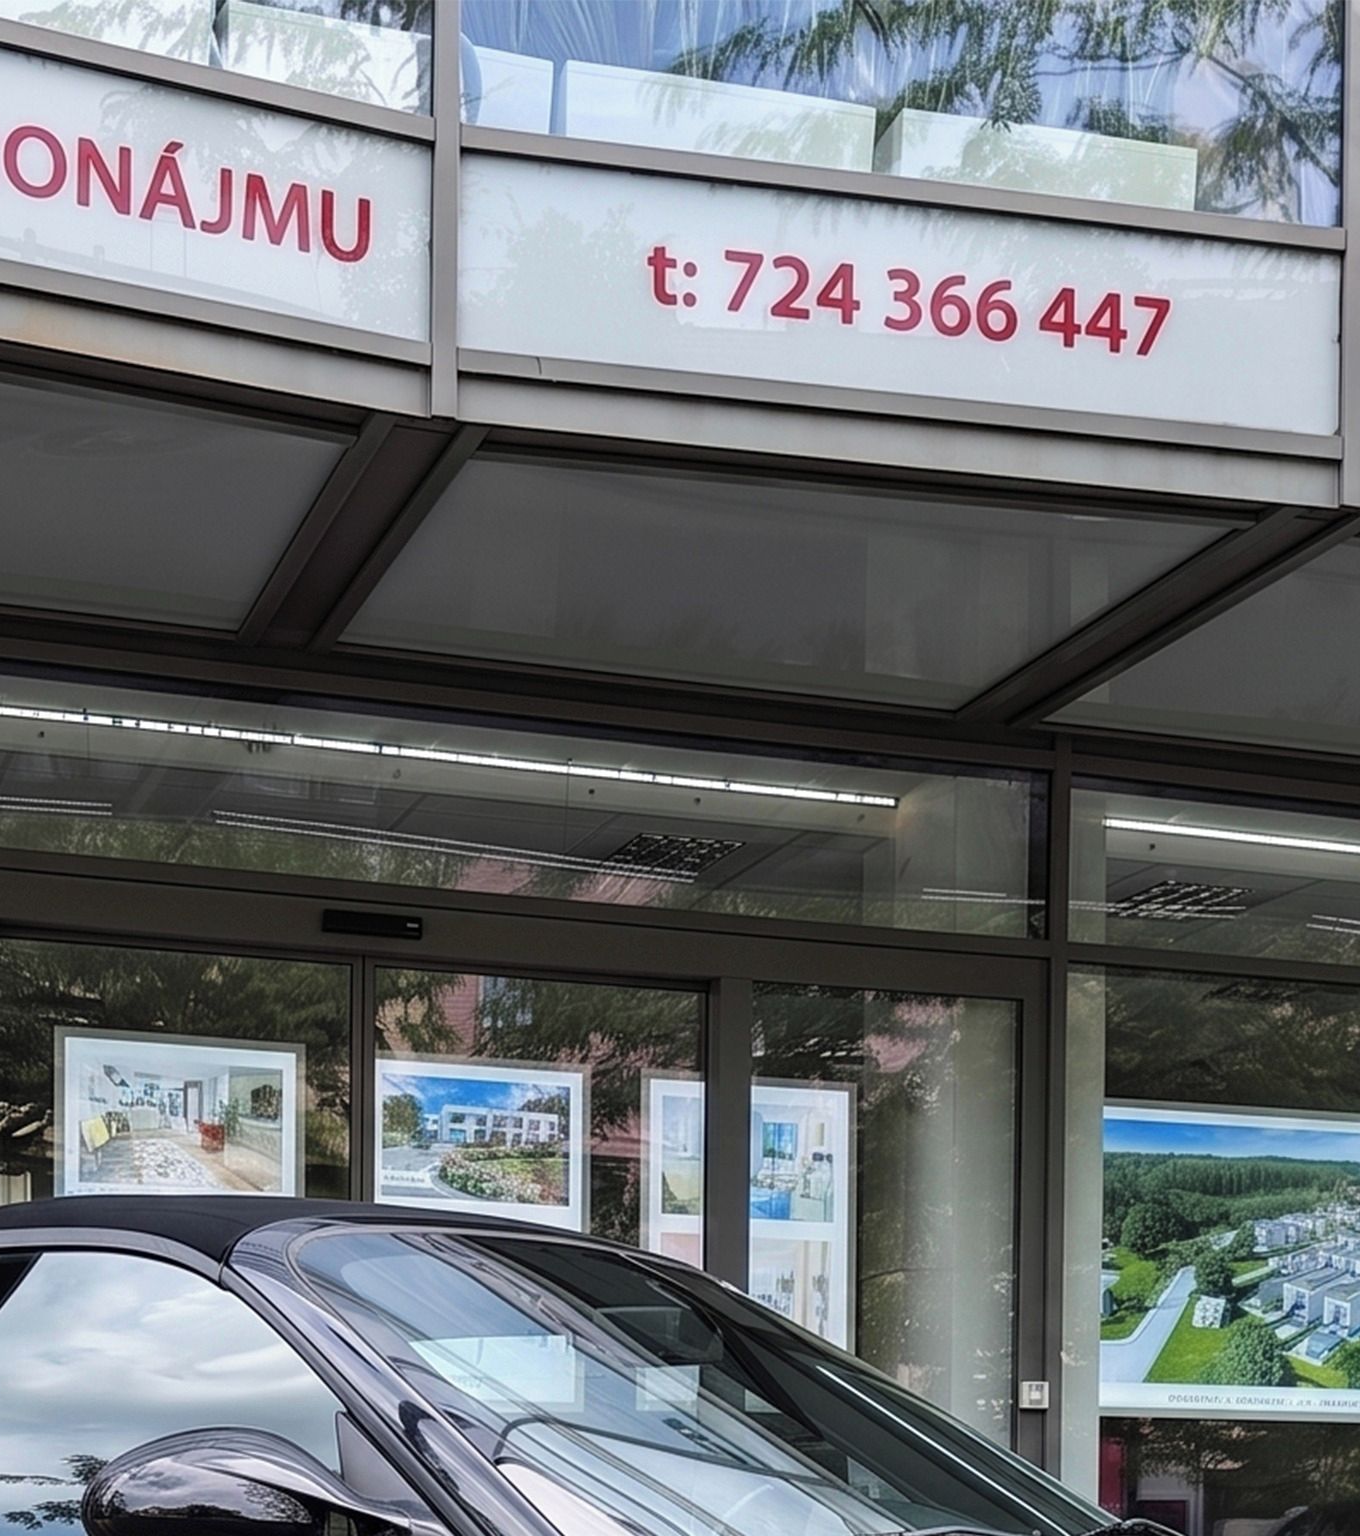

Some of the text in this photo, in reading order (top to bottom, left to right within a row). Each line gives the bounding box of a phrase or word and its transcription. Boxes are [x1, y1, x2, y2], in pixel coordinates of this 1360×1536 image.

[647, 246, 1172, 357] t: 724 366 447
